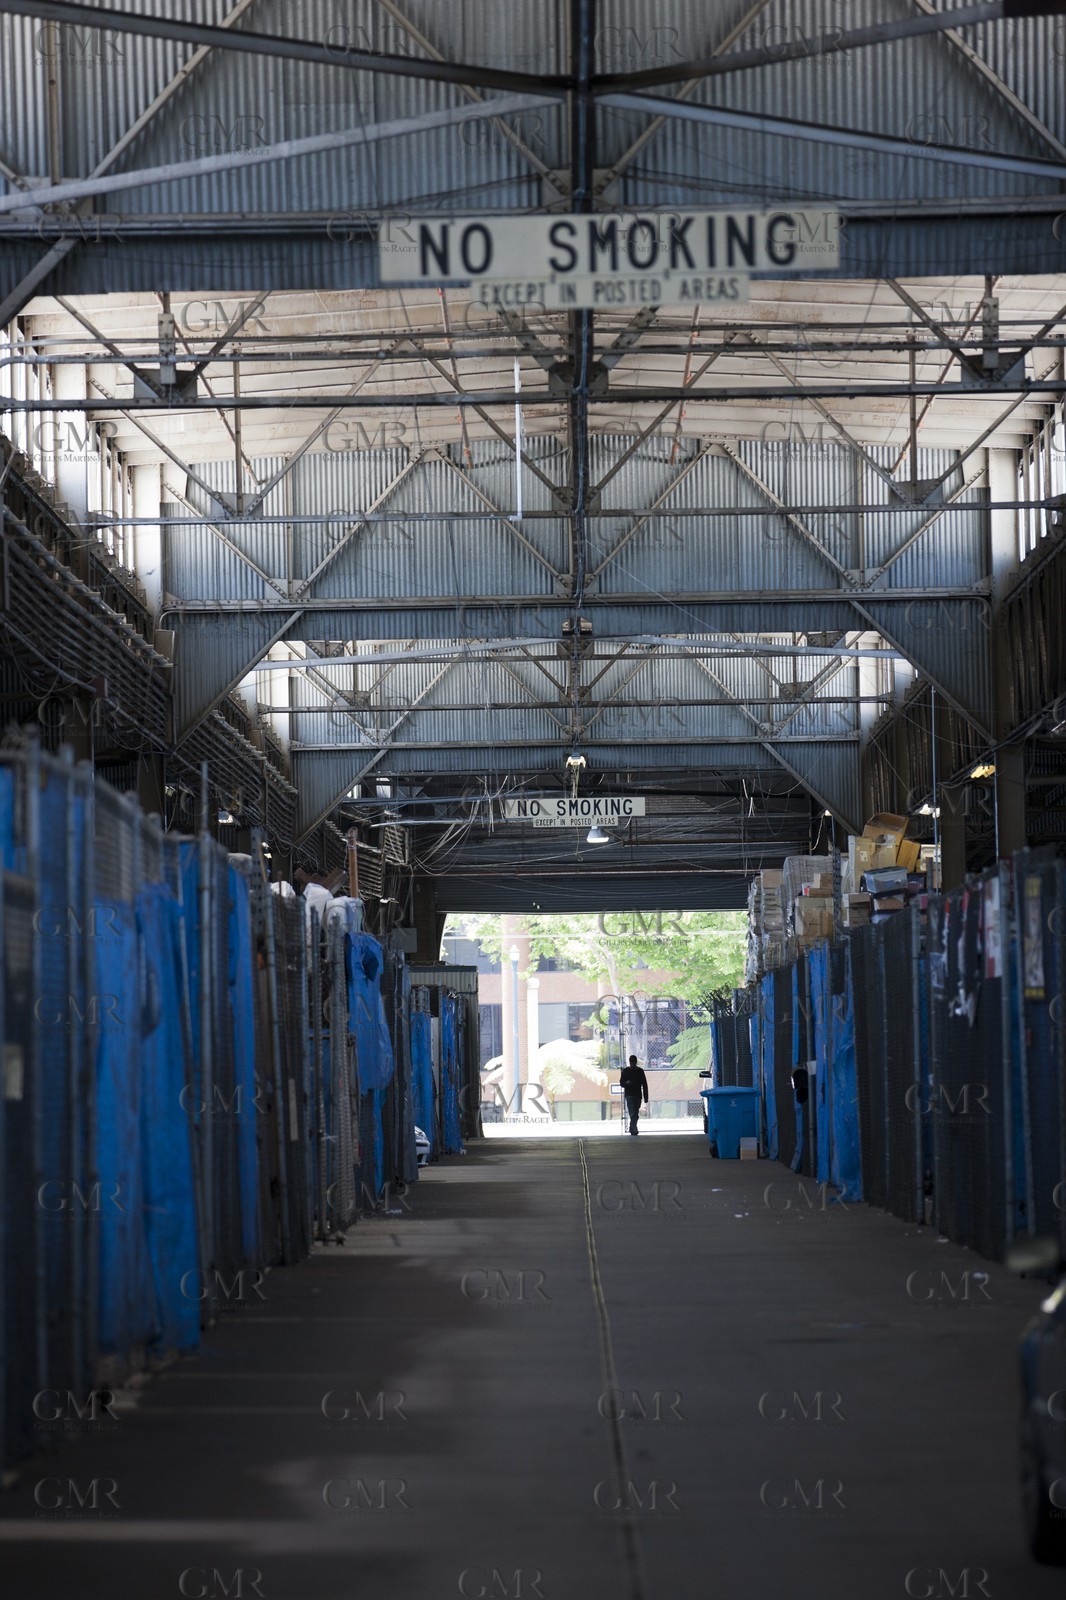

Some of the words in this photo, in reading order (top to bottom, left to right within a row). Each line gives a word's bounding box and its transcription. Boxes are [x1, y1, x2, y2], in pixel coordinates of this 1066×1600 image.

[420, 222, 493, 276] NO
[549, 214, 798, 274] SMOKING
[480, 280, 546, 305] EXCEPT
[560, 279, 577, 303] IN
[594, 278, 662, 302] POSTED
[679, 276, 740, 301] AREAS
[517, 800, 540, 816] NO
[556, 799, 633, 816] SMOKING
[535, 818, 556, 827] EXCEPT
[560, 818, 566, 826] IN
[571, 817, 591, 825] POSTED
[597, 817, 615, 825] AREAS
